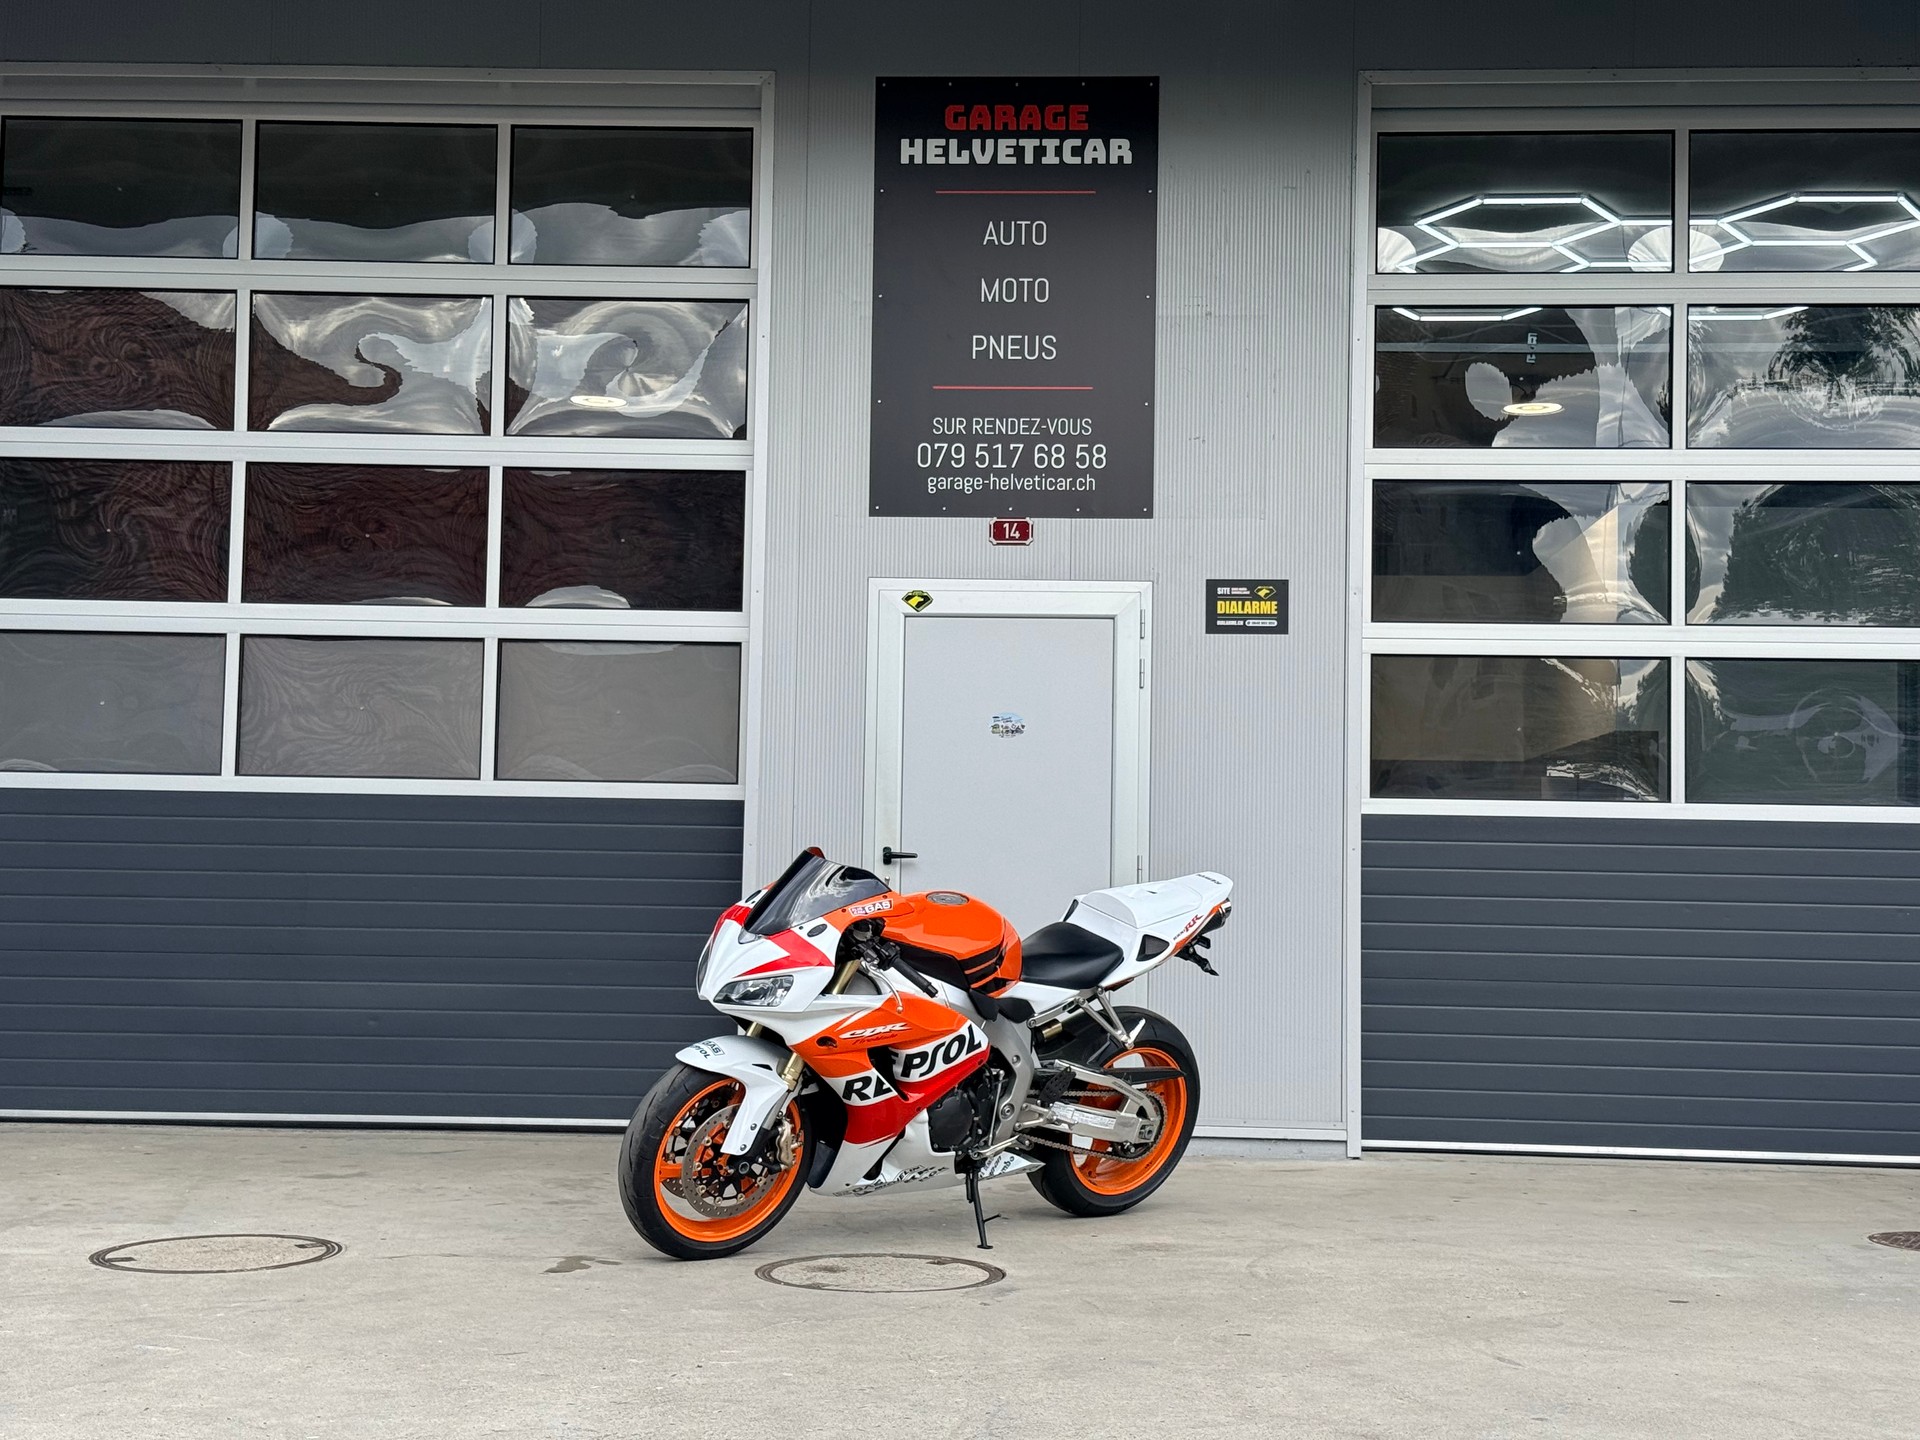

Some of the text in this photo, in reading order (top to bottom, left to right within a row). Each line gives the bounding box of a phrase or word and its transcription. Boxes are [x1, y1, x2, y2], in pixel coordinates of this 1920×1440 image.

[944, 104, 1089, 131] GARAGE
[900, 138, 1133, 165] HELVETICAR
[983, 221, 1048, 246] AUTO
[980, 278, 1050, 303] MOTO
[971, 335, 1057, 360] PNEUS
[932, 418, 1093, 436] SUR RENDEZ-VOUS
[916, 443, 1107, 469] 079 517 68 58
[927, 473, 1096, 494] garage-helveticar.ch
[1003, 523, 1021, 539] 14
[1217, 601, 1277, 614] DIALARME
